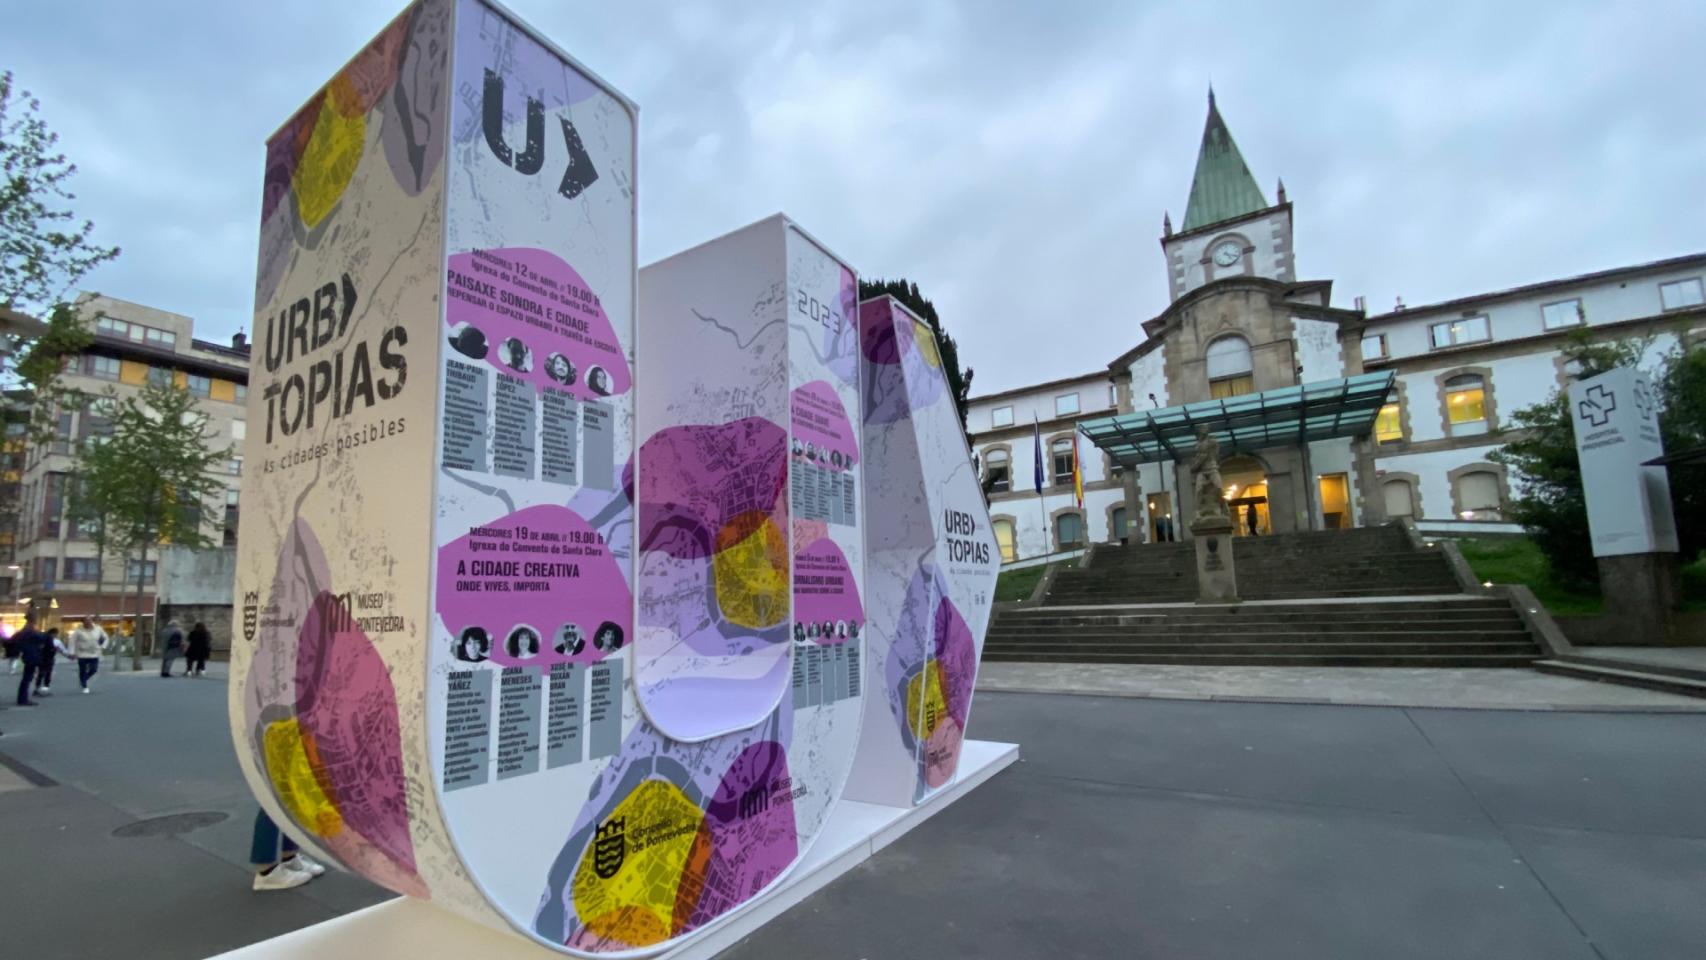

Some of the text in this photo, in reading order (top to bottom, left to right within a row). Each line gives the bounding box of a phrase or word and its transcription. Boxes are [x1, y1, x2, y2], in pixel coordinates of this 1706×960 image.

[472, 259, 600, 318] Igrexa do Convento de Santa Clara
[515, 262, 528, 277] 12
[529, 271, 539, 283] DE
[567, 284, 592, 303] 19.00
[594, 293, 600, 307] h
[447, 270, 589, 333] PAISAXE SONORA E CIDADE
[489, 301, 494, 310] O
[496, 305, 524, 321] ESPAZO
[798, 289, 840, 335] 2023
[263, 325, 408, 444] TOPIAS
[280, 442, 328, 470] cidades
[336, 417, 406, 457] posibles
[515, 526, 528, 540] 19
[530, 531, 539, 541] DE
[541, 531, 561, 542] ABRIL
[569, 531, 595, 544] 19.00
[598, 533, 604, 544] h
[469, 540, 602, 556] Igrexa do Convento de Santa Clara
[946, 537, 989, 564] TOPIAS
[457, 560, 580, 578] A CIDADE CREATIVA
[456, 581, 550, 592] ONDE VIVES, IMPORTA
[357, 593, 383, 608] MUSEO
[357, 616, 404, 632] PONTEVEDRA
[449, 670, 473, 681] MARÍA
[449, 680, 471, 690] YÁÑEZ
[631, 823, 698, 853] de Pontevedra
